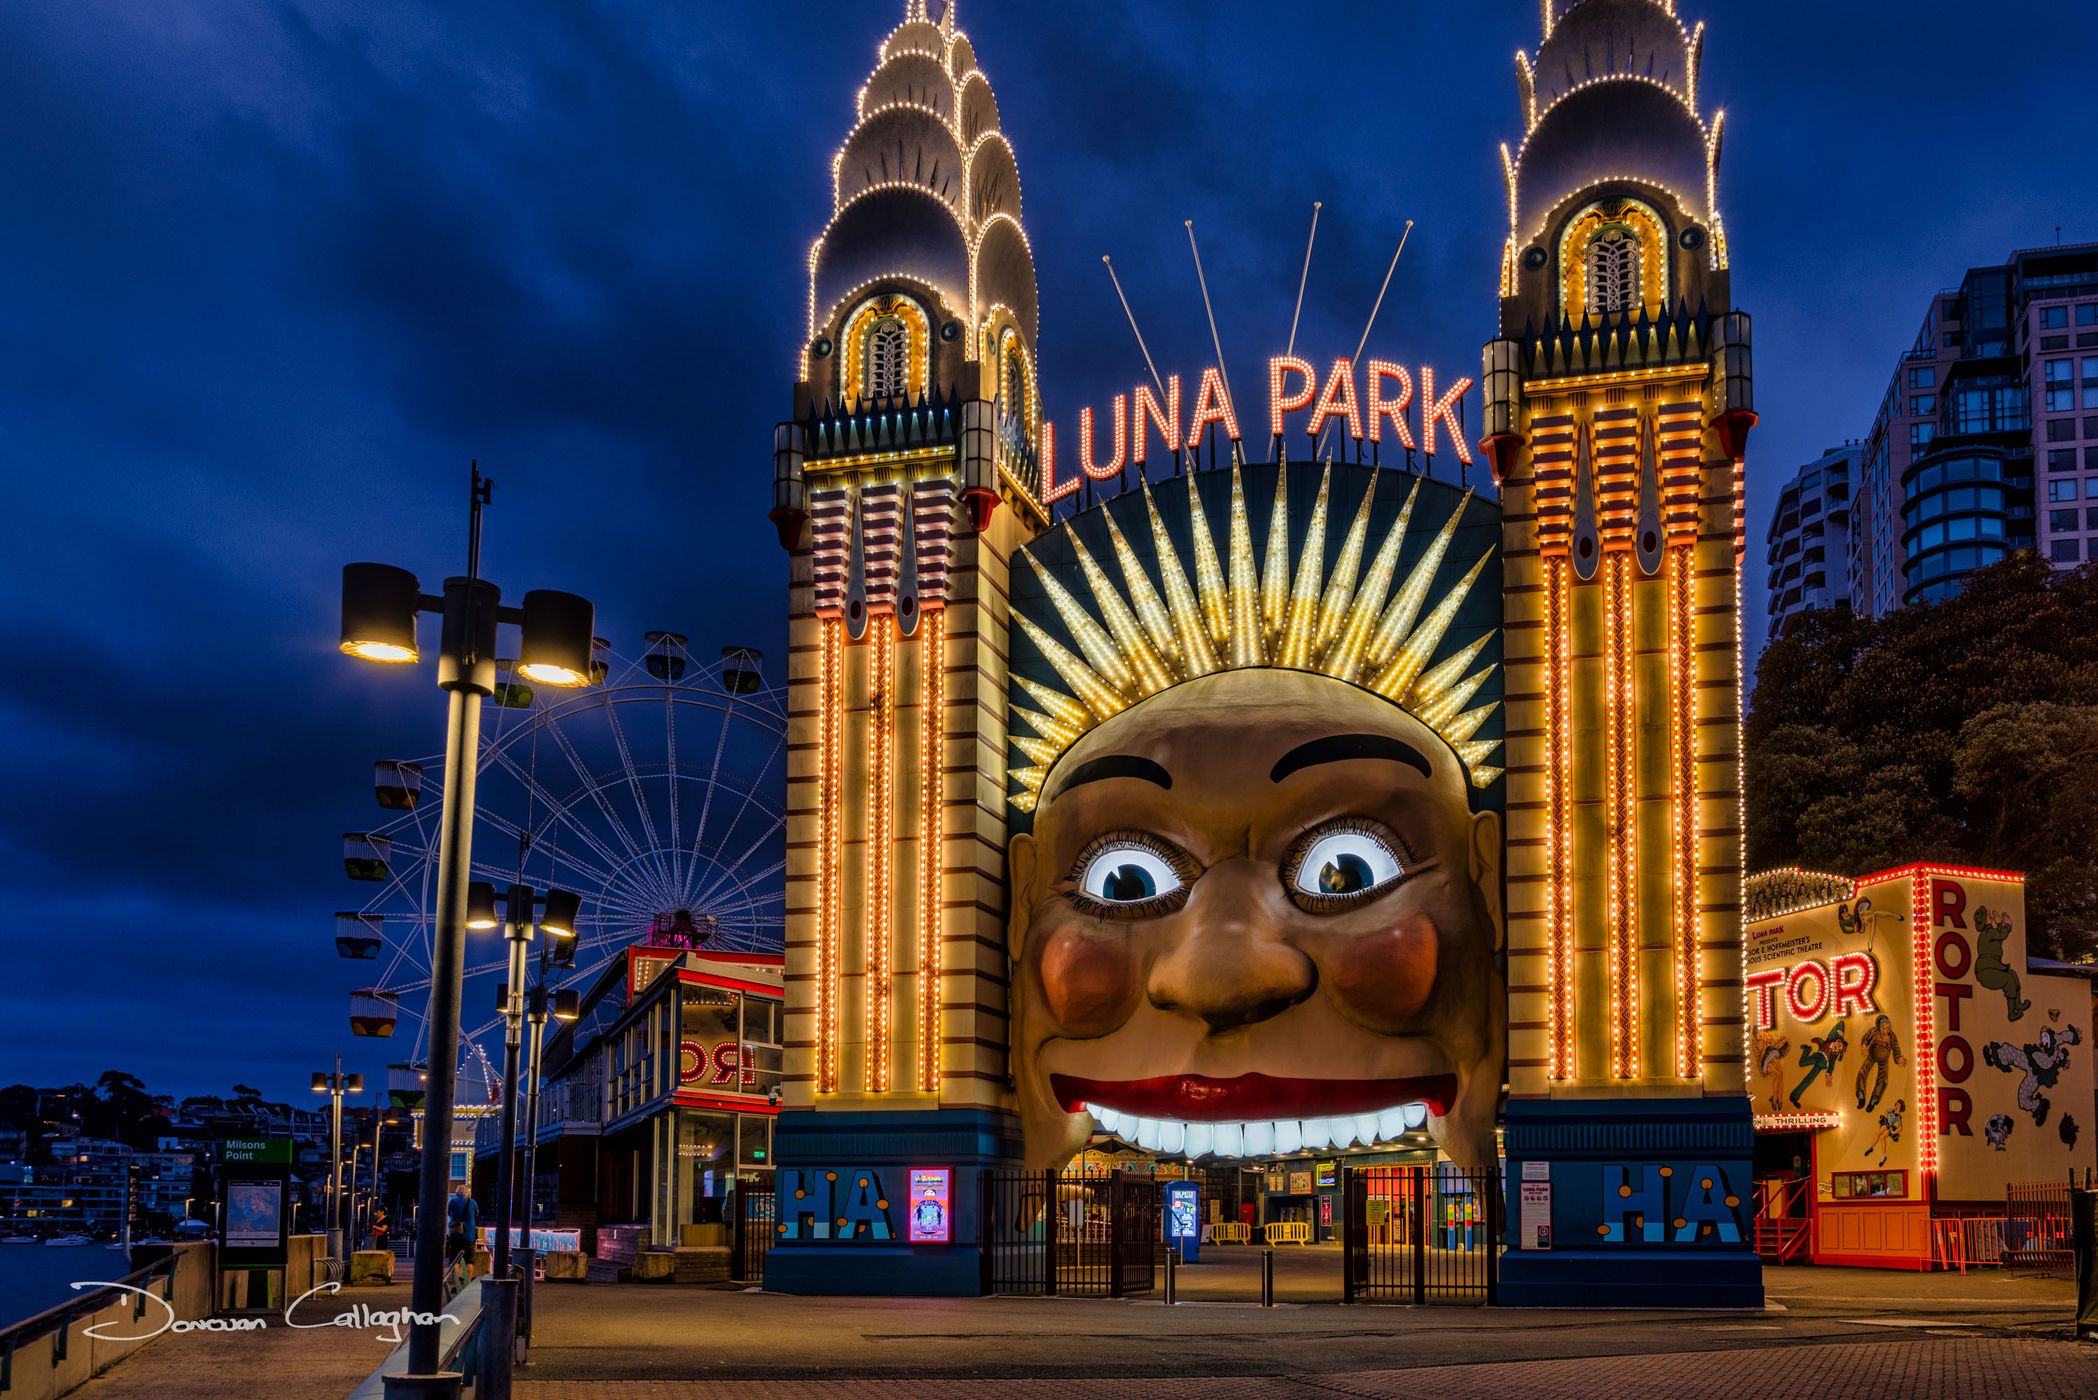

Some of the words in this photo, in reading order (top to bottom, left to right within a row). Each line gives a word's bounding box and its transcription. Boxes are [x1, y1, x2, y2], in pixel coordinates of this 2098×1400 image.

[1042, 367, 1242, 504] LUNA
[1269, 355, 1474, 466] PARK
[1769, 925, 1784, 936] PARK
[1763, 948, 1795, 961] SCIENTIFIC
[1797, 942, 1822, 954] THEATRE
[1766, 936, 1810, 951] HOFFMEISTER'S
[1932, 879, 1974, 1136] ROTOR
[1775, 1117, 1827, 1125] THRILLING
[226, 1140, 266, 1149] Milsons
[226, 1151, 253, 1160] Point
[781, 1169, 894, 1240] HA
[1601, 1163, 1745, 1243] HA
